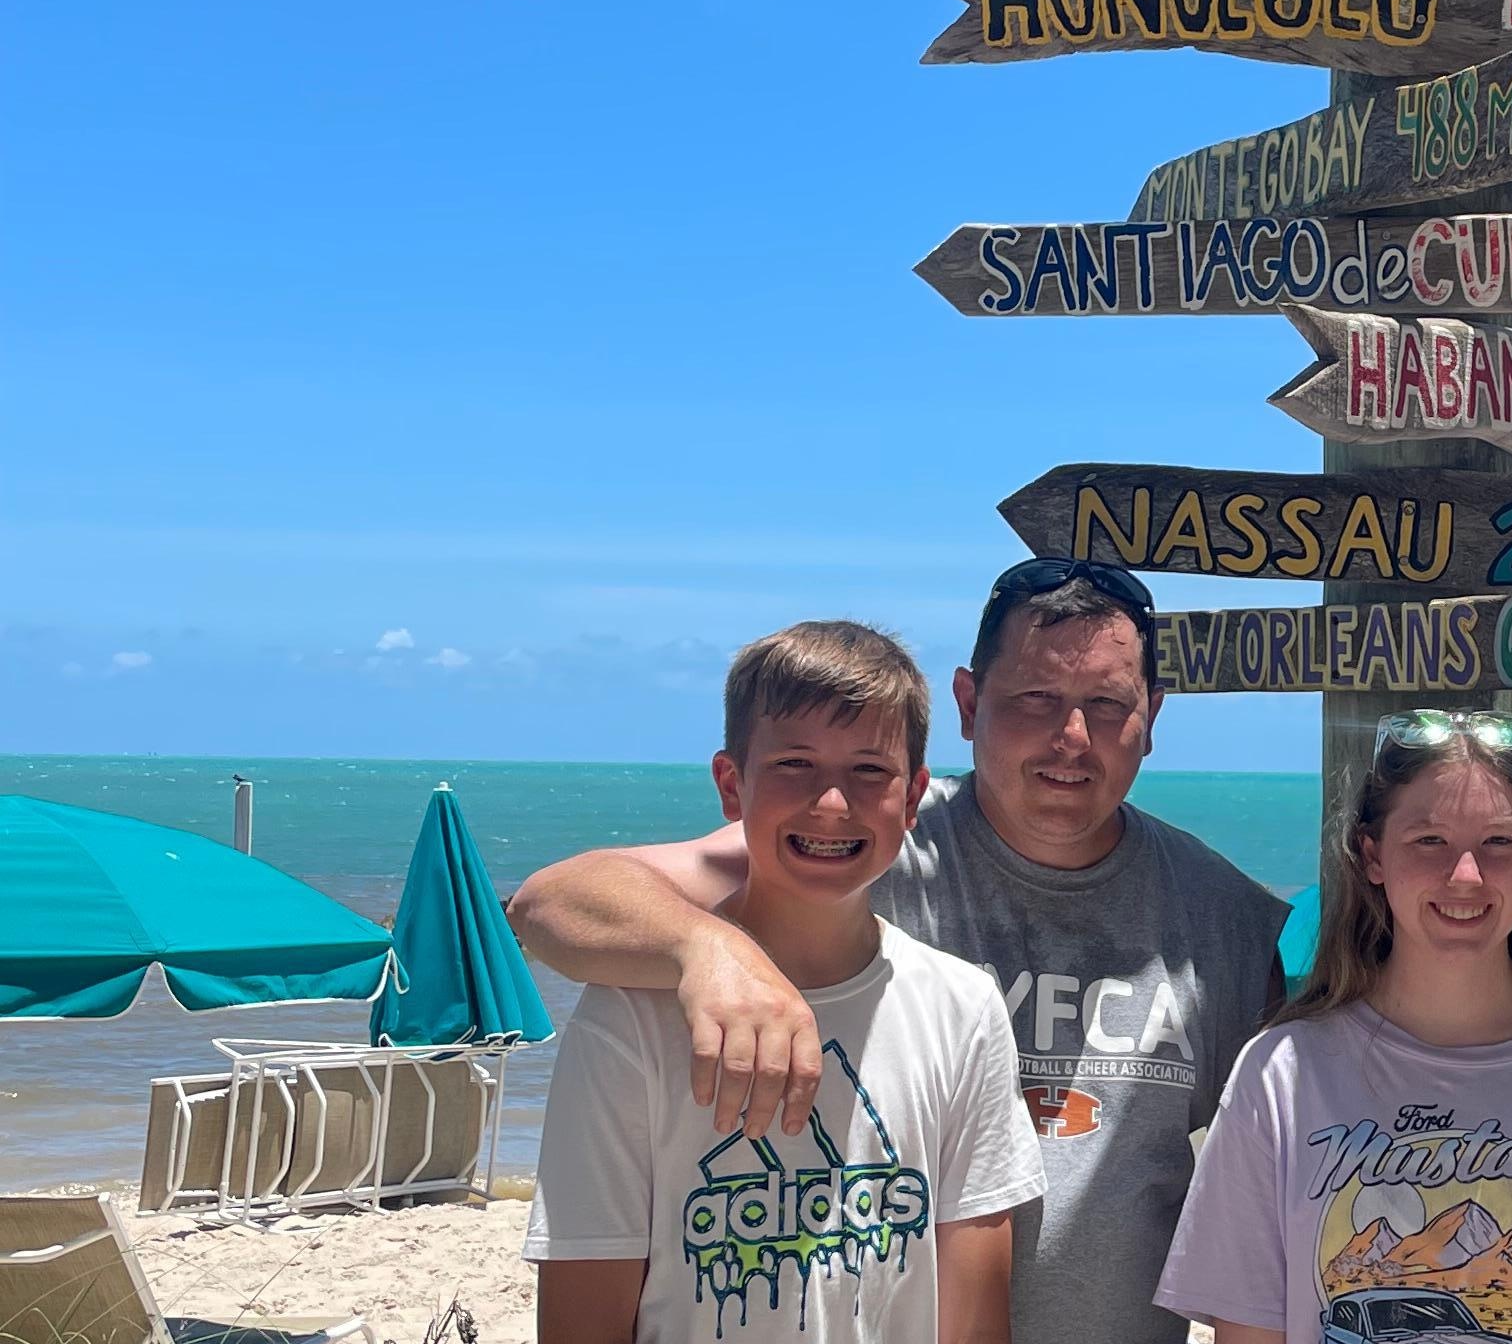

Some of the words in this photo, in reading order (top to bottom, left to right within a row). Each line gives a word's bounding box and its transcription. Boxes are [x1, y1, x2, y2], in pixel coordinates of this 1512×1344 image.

[1396, 67, 1479, 182] 488
[978, 216, 1328, 314] SANTIAGO
[1329, 219, 1412, 307] de
[1072, 483, 1454, 583] NASSAU
[1234, 600, 1482, 693] ORLEANS
[1077, 1059, 1118, 1076] CHEER
[1121, 1061, 1197, 1084] ASSOCIATION
[1394, 1104, 1455, 1131] Ford
[685, 1168, 930, 1248] adidas
